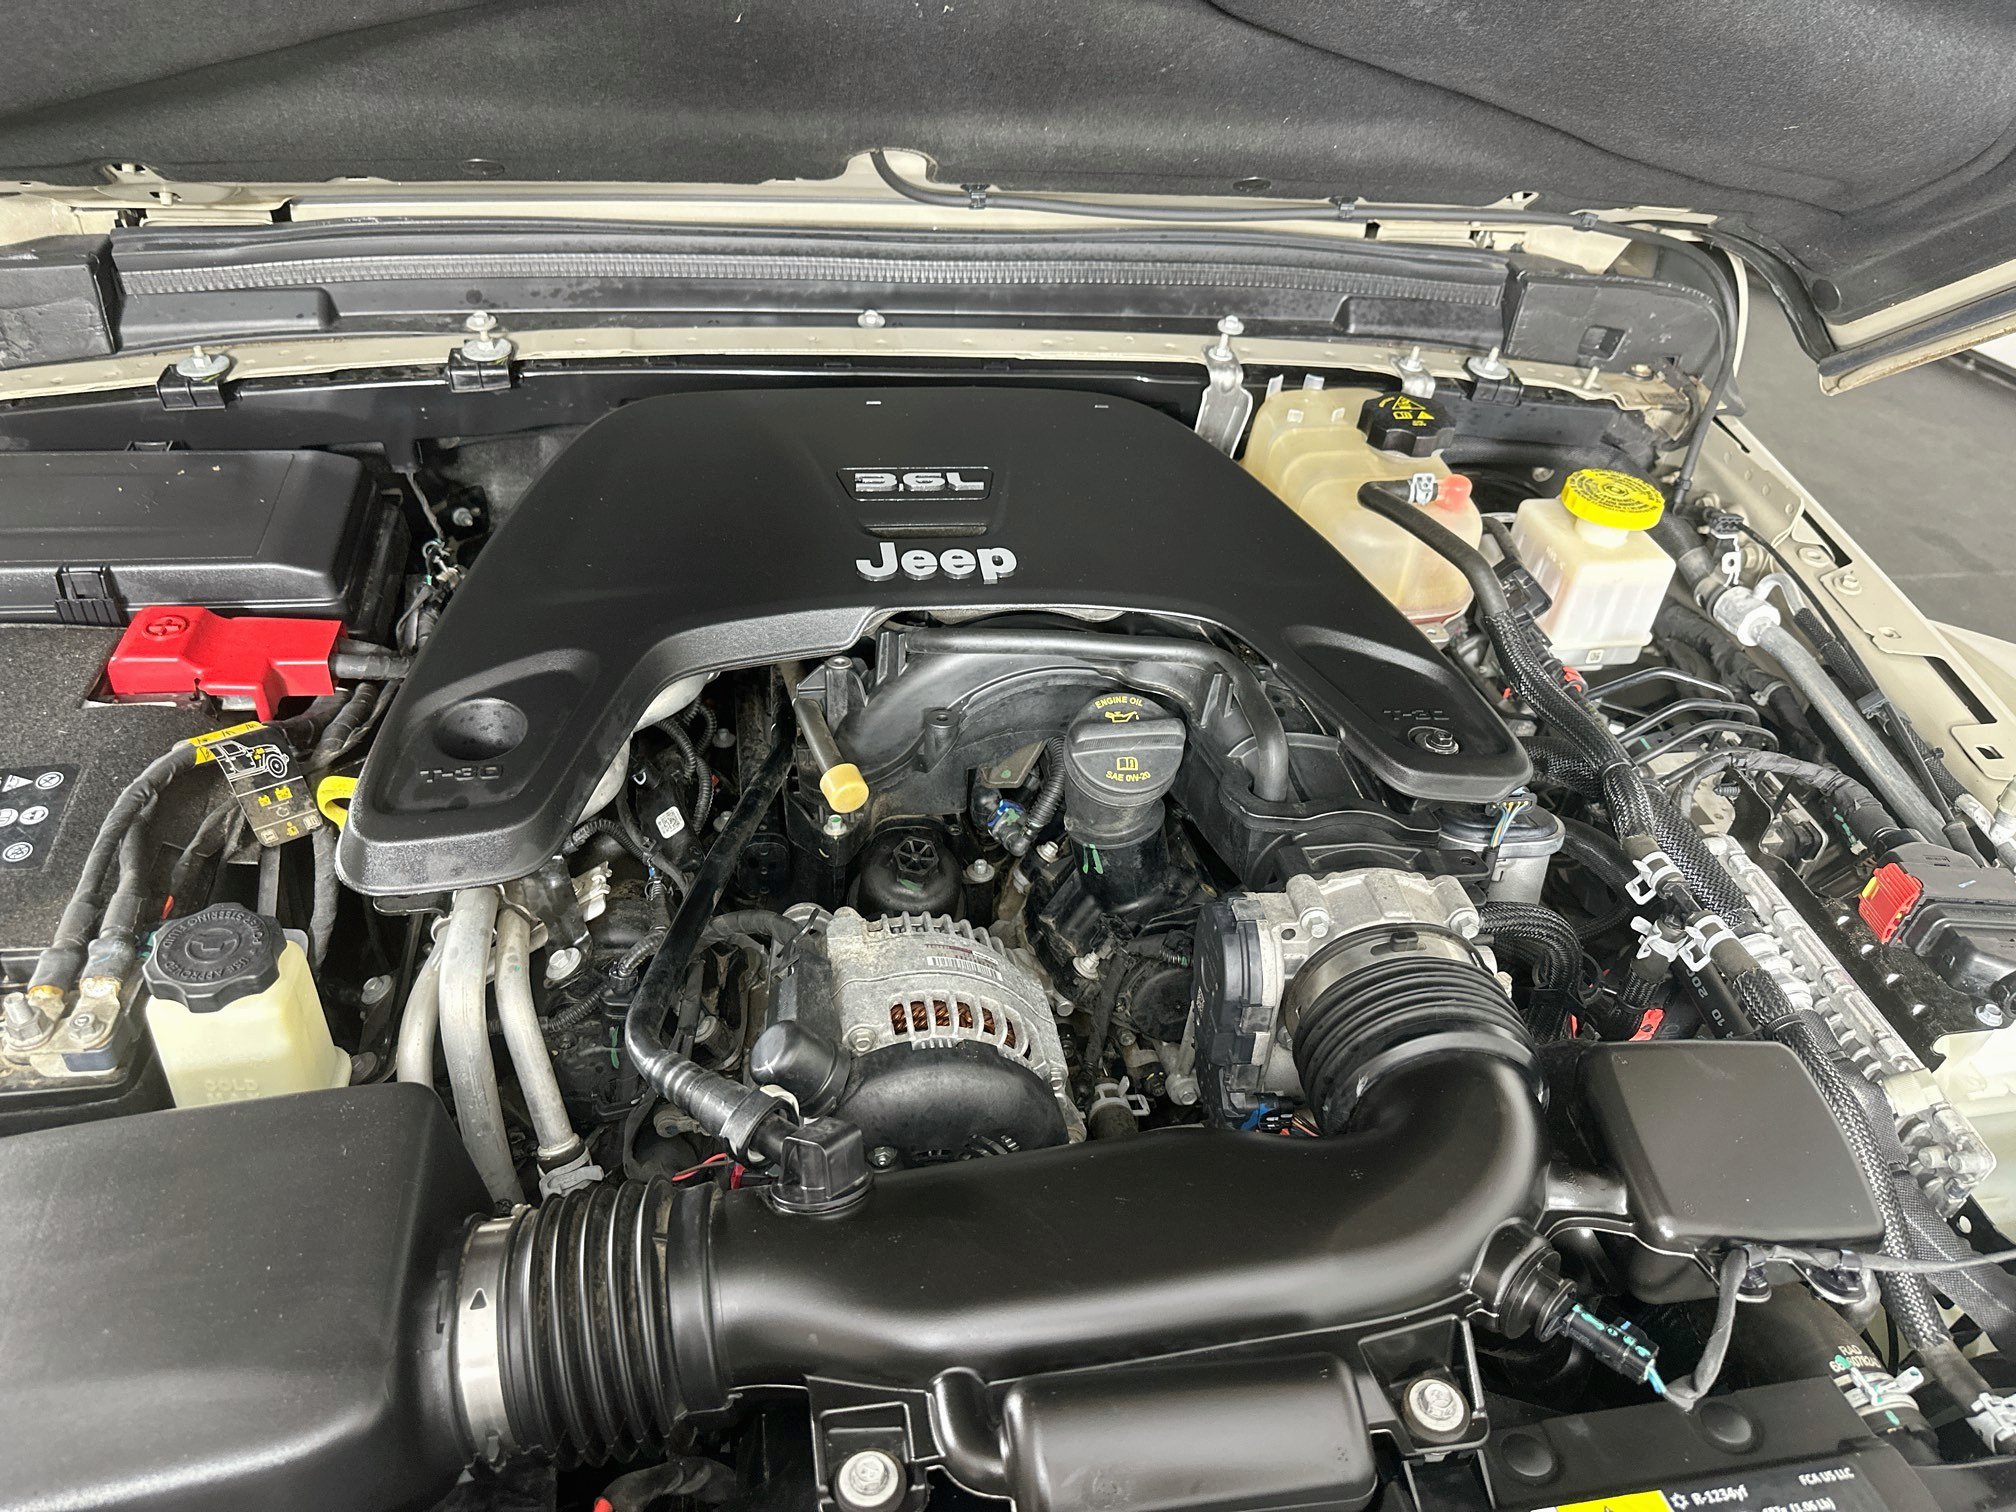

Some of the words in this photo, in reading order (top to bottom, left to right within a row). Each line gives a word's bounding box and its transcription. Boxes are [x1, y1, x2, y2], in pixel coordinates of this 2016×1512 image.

[855, 472, 985, 492] 3.6L
[856, 541, 1018, 585] Jeep
[1094, 695, 1128, 709] ENGINE
[1129, 697, 1144, 707] OIL
[1105, 770, 1125, 782] SAE
[1125, 771, 1152, 782] 0W-20
[187, 910, 244, 927] STEERING
[163, 924, 188, 949] FLUID
[164, 960, 225, 982] APPROVED
[227, 955, 251, 974] USE
[1838, 1344, 1863, 1356] RAD
[1798, 1472, 1823, 1487] FCA
[1819, 1469, 1837, 1483] US
[1834, 1466, 1855, 1481] LLC
[1690, 1483, 1749, 1506] R-1234yf
